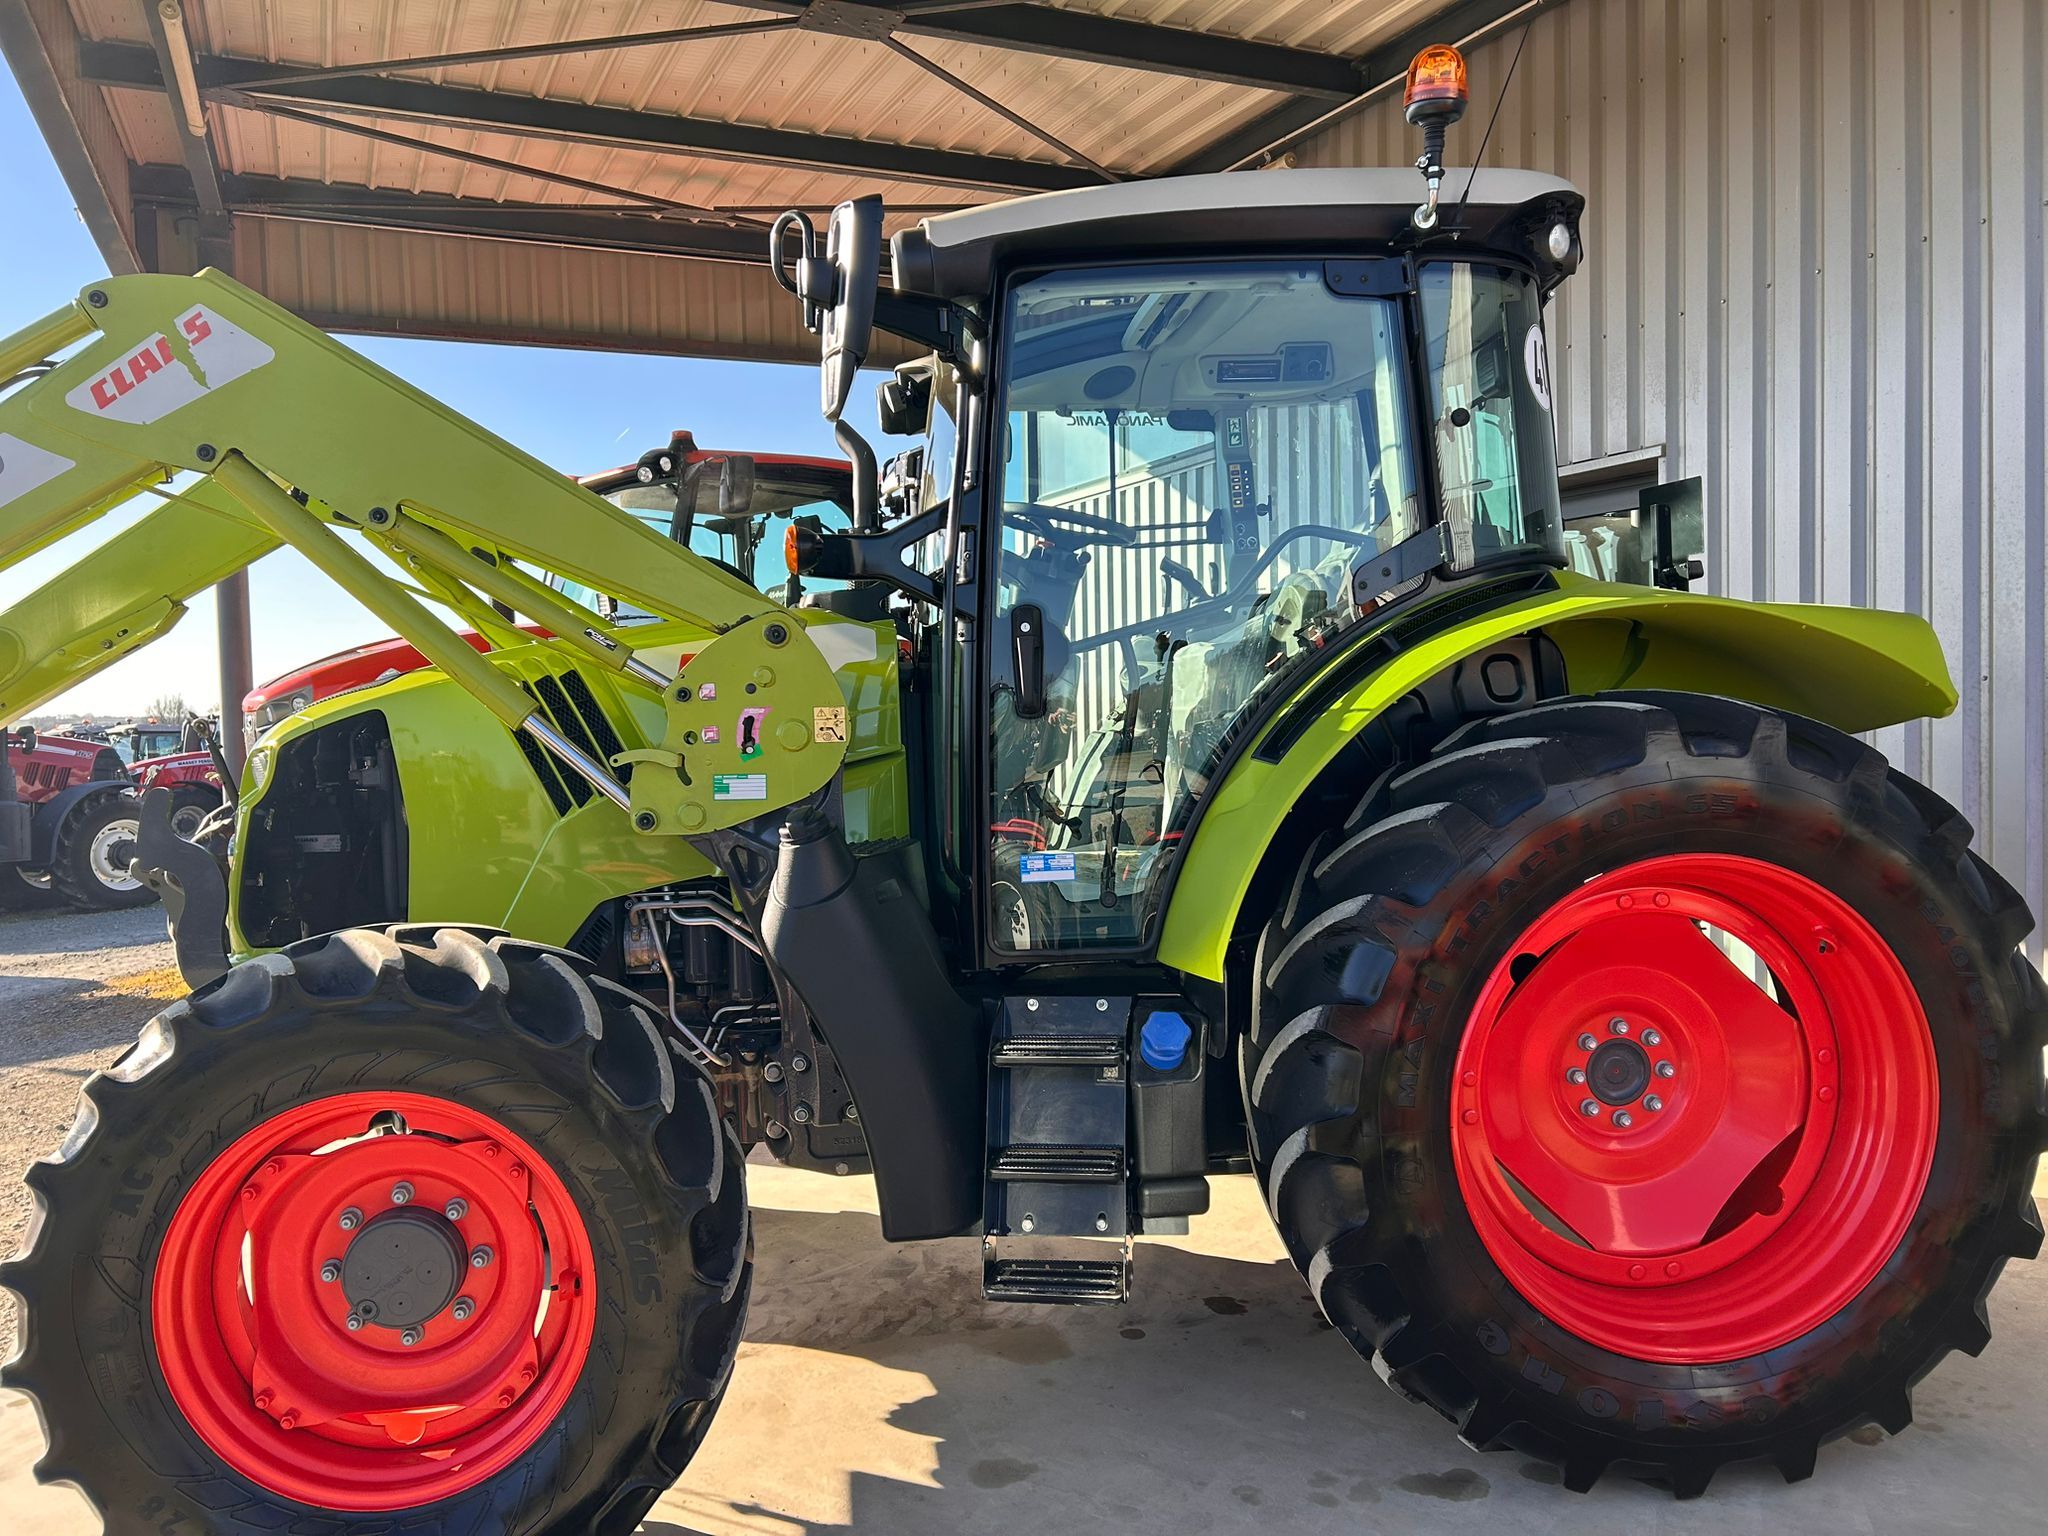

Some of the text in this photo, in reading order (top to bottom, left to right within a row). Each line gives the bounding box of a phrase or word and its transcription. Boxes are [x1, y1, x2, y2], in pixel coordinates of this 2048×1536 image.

[1399, 791, 1739, 1106] MAXI TRACTION 65
[108, 1162, 157, 1218] AC
[587, 1155, 662, 1304] Mitas
